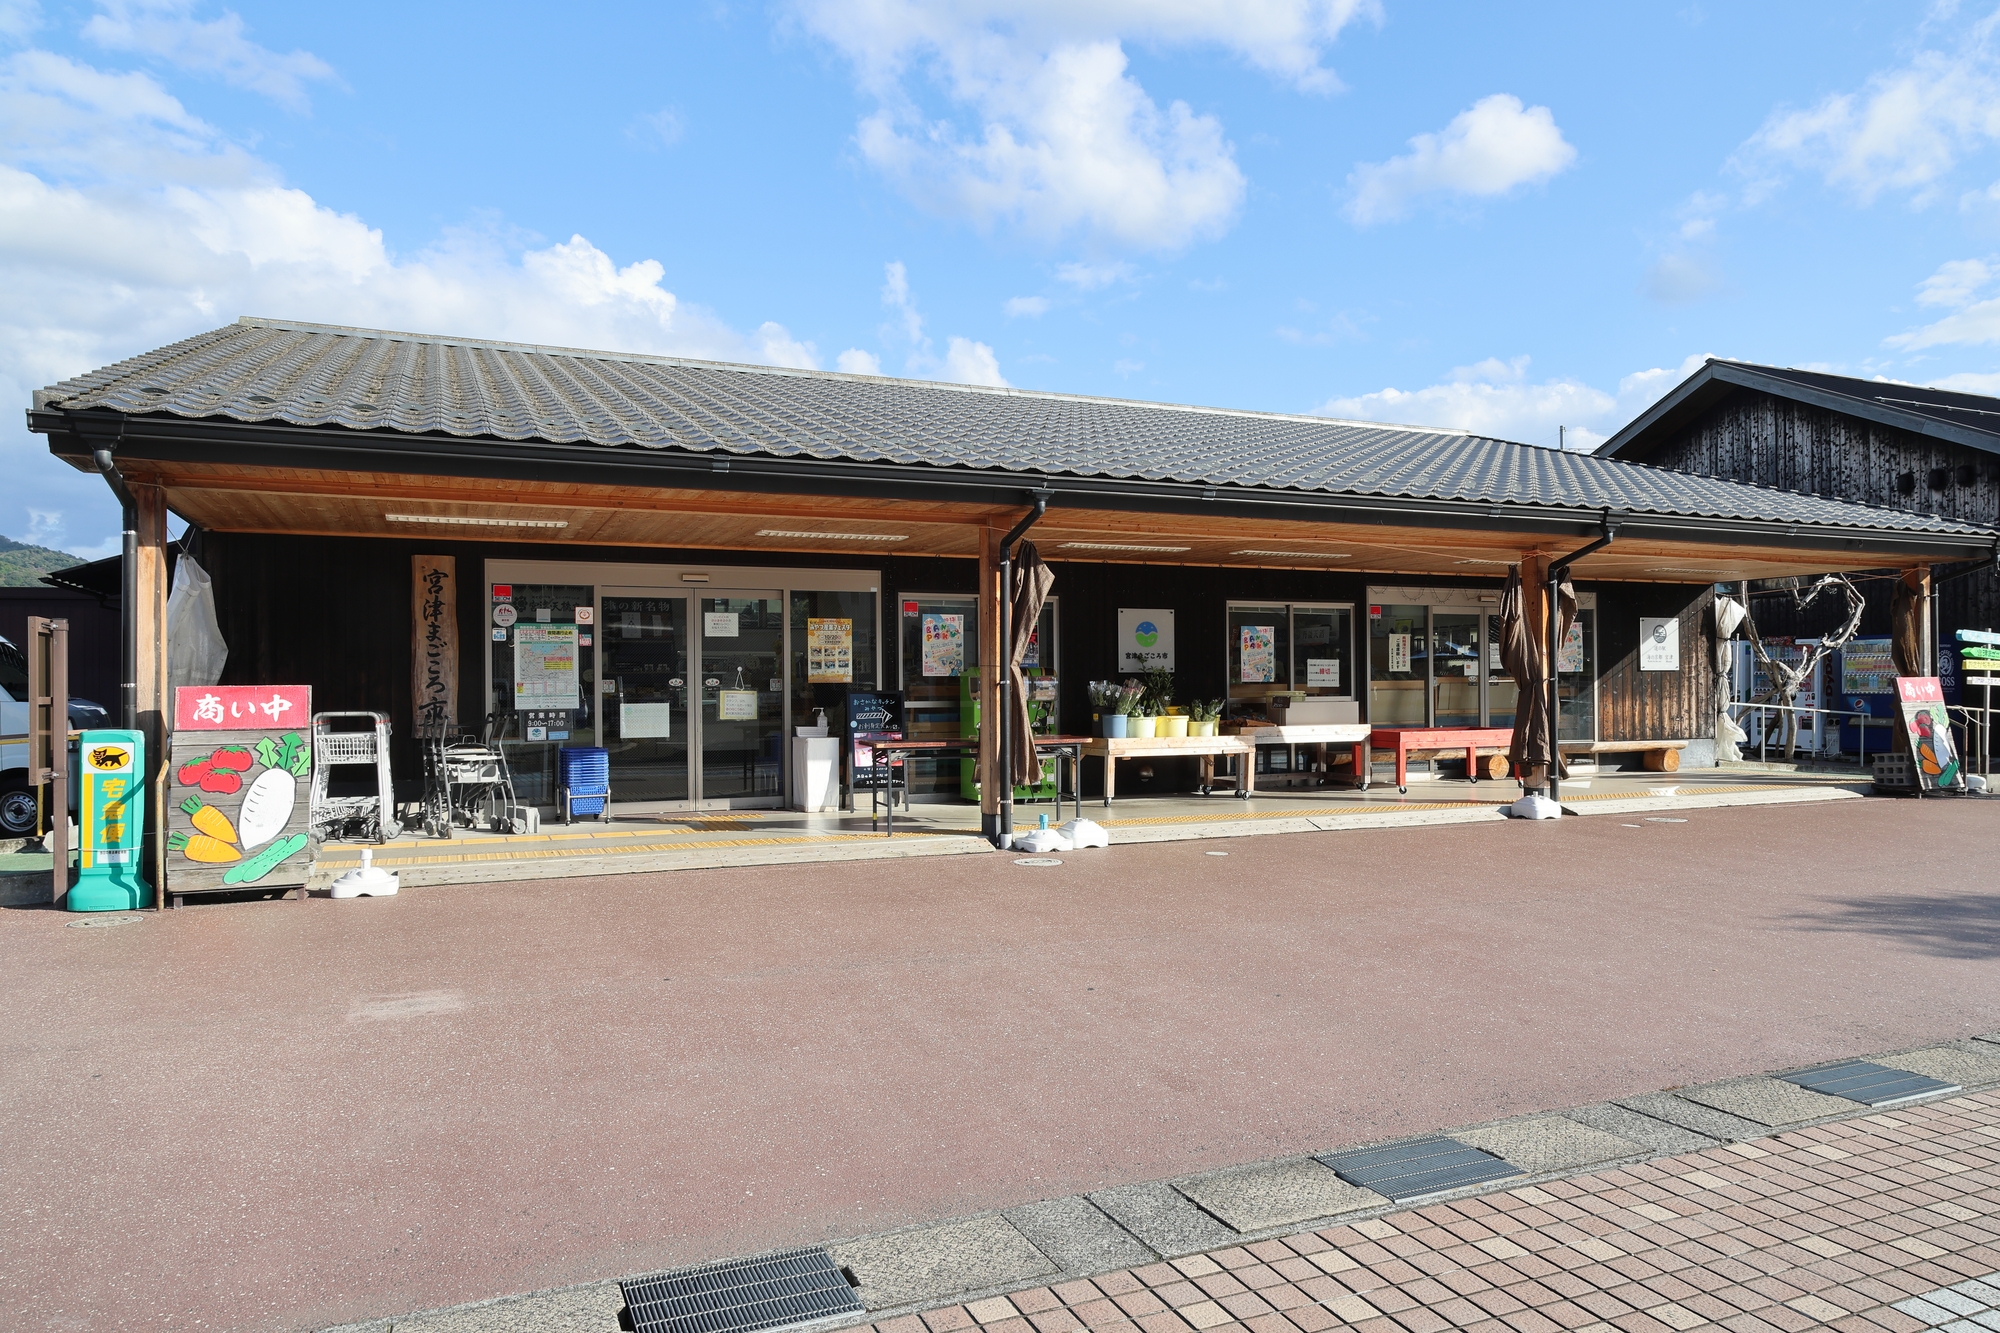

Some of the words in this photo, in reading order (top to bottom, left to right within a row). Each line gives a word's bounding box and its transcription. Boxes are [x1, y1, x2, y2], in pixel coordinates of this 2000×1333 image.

[418, 568, 449, 726] 宮津まごころ市
[1825, 653, 1835, 697] DyDo
[1904, 681, 1936, 698] 商い中
[1940, 676, 1955, 687] OSS
[193, 693, 293, 724] 商い中
[528, 711, 566, 719] 営業時間
[99, 777, 127, 844] 宅急便
